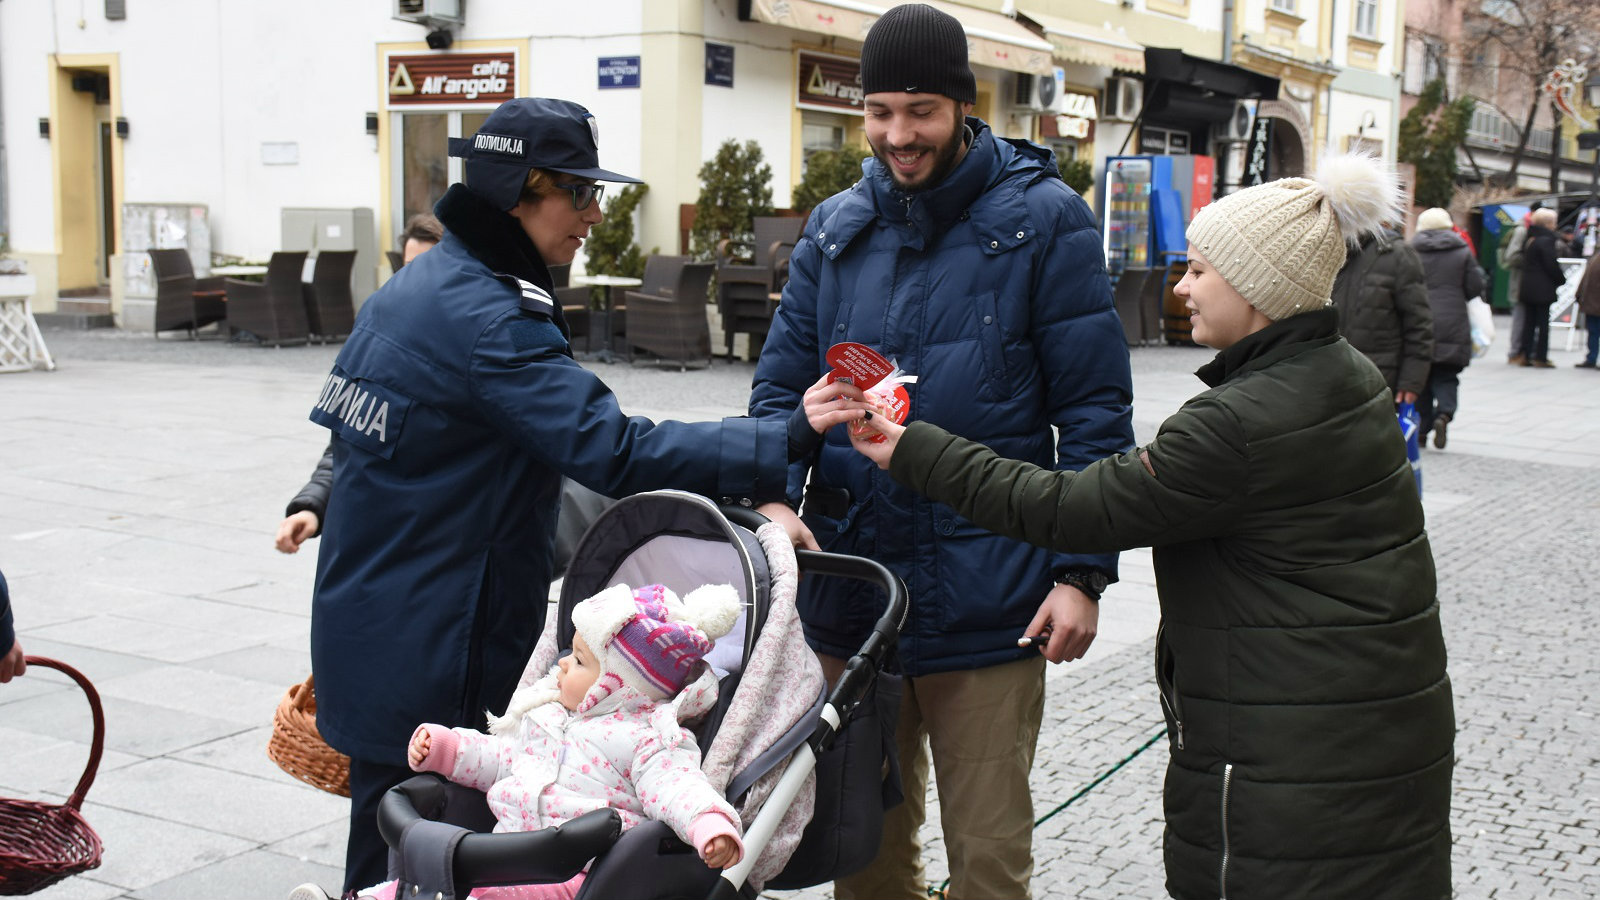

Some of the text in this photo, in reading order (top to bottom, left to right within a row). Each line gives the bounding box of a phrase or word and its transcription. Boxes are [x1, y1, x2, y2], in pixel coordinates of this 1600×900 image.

[472, 60, 510, 76] caffe
[421, 75, 507, 99] All'angolo
[474, 134, 523, 155] ПОЛИЦИЈА
[843, 350, 857, 361] ВАМ
[850, 367, 867, 382] ДРАГИ
[856, 359, 880, 377] ЖЕЛИМО
[871, 362, 888, 375] ПУНО
